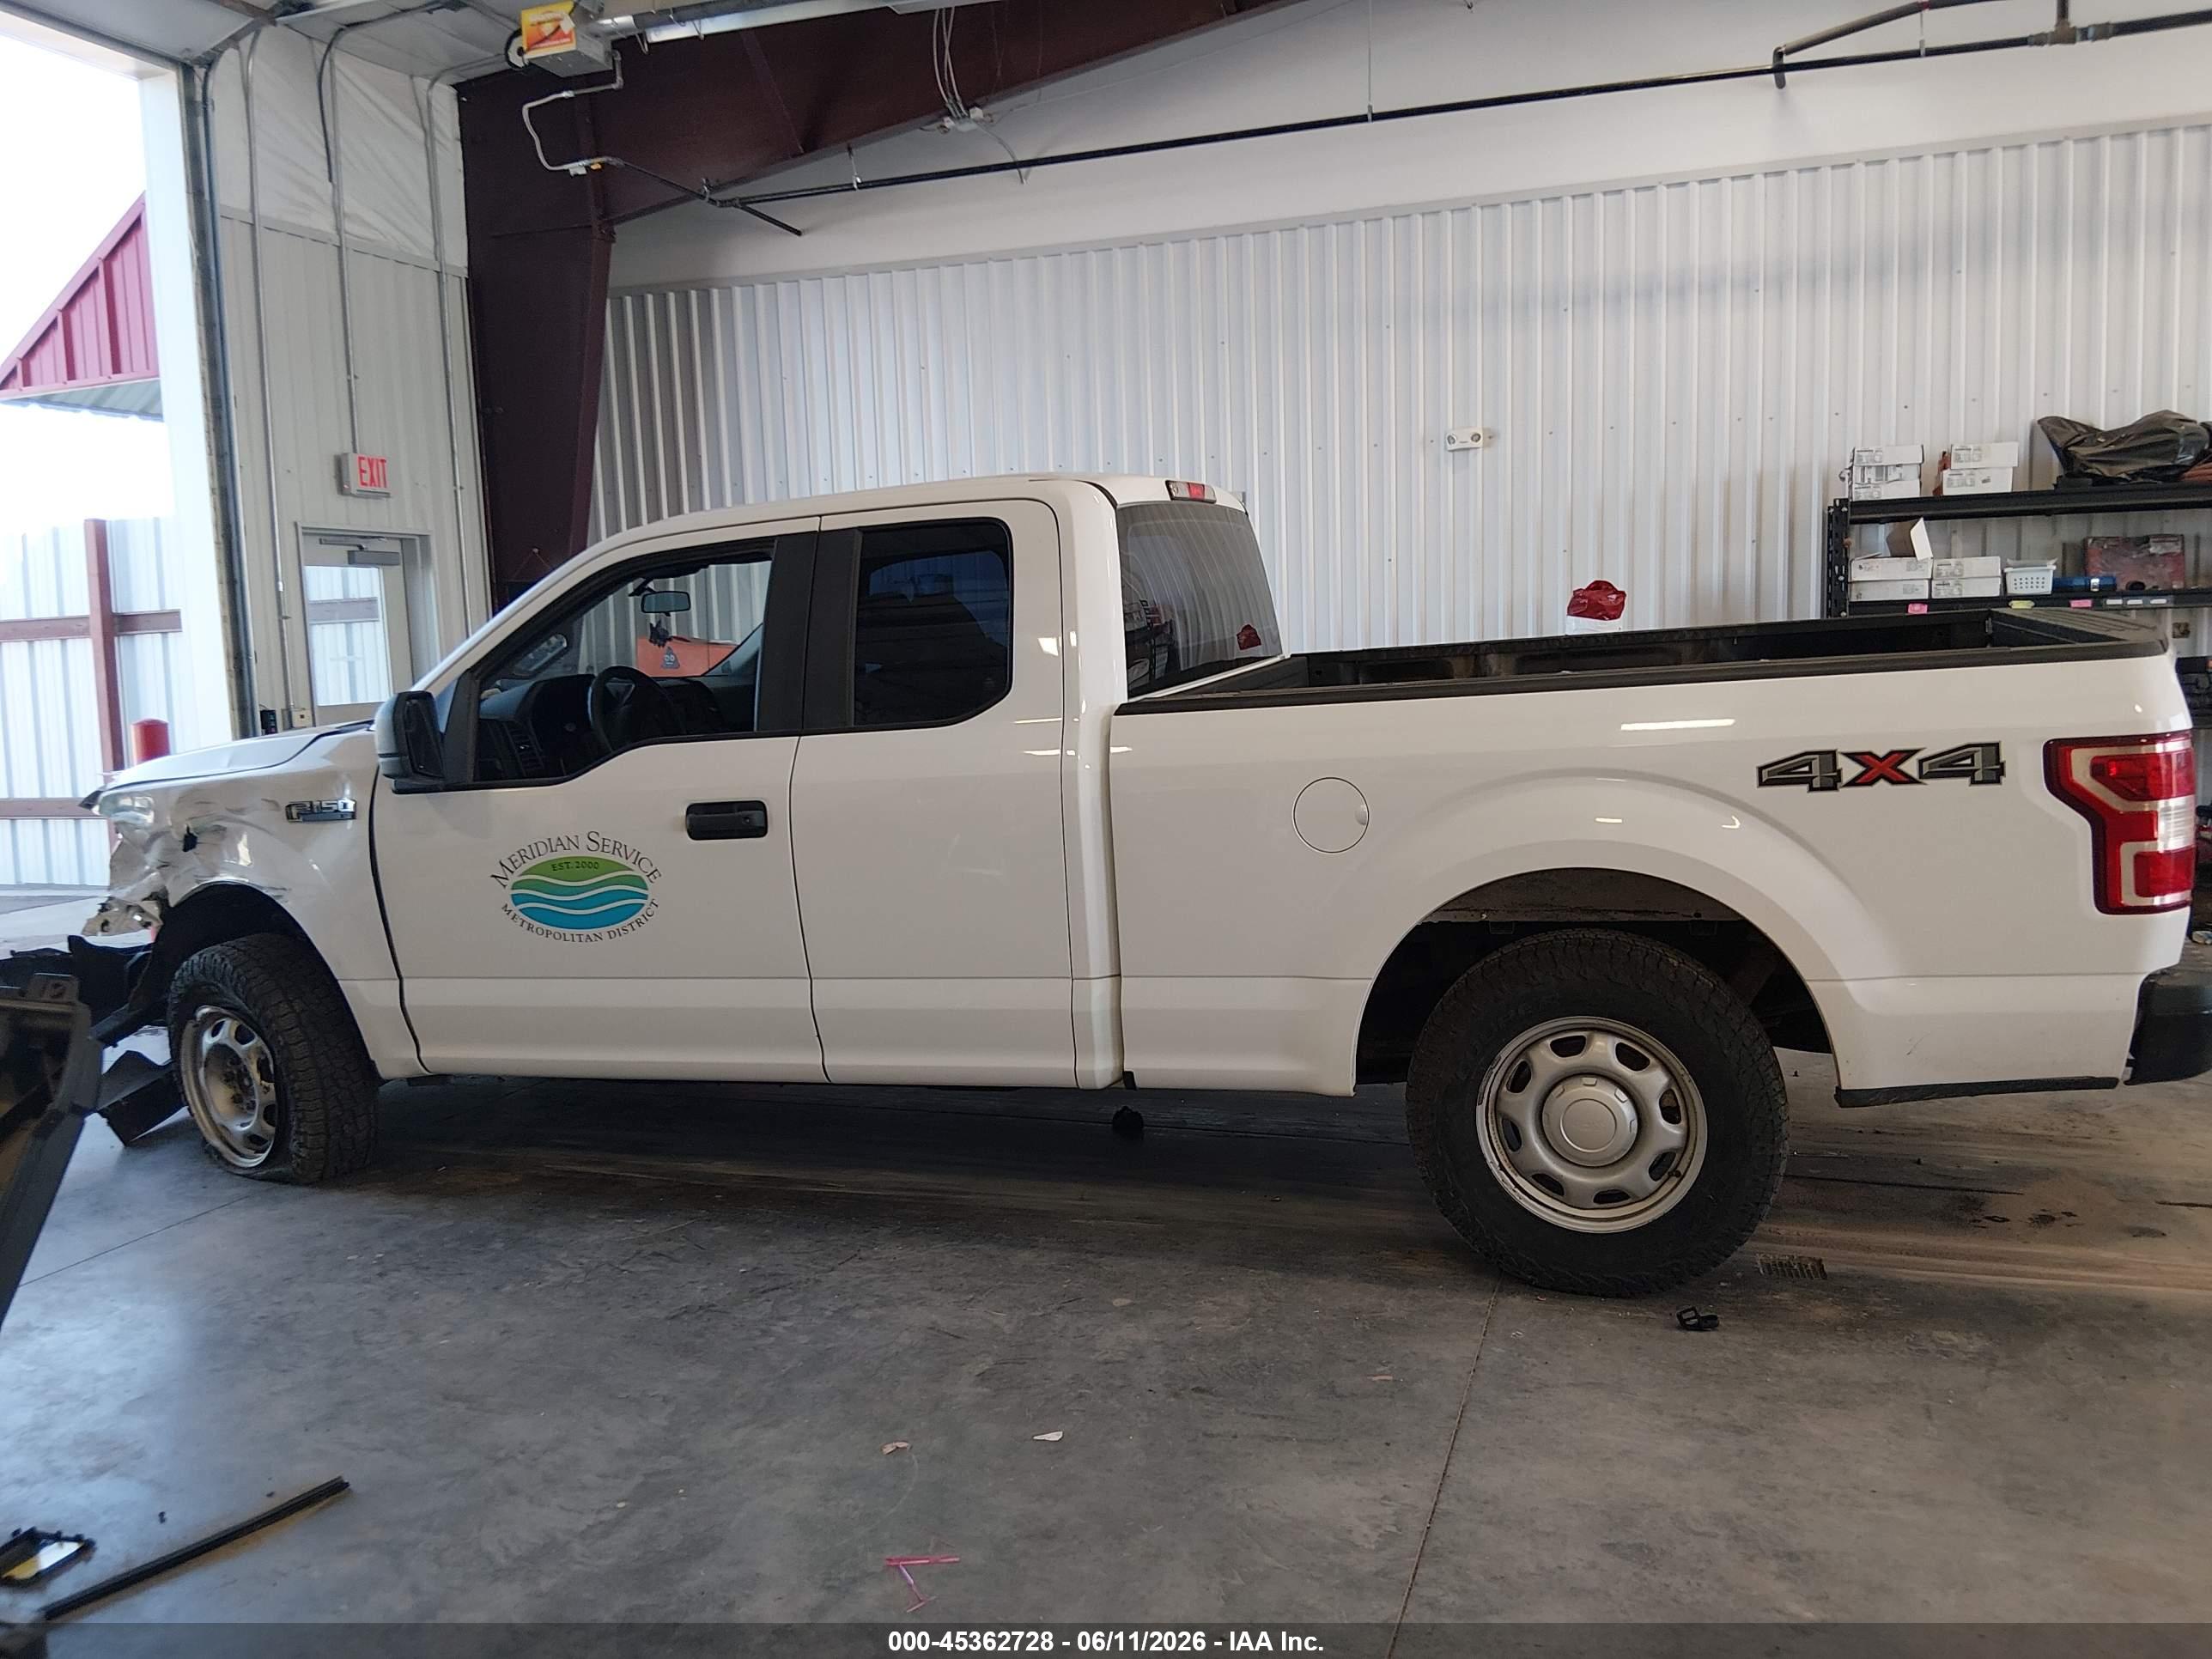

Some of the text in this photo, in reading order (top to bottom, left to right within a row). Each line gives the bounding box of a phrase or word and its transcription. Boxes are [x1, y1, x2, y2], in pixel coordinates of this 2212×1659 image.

[357, 456, 387, 489] EXIT
[490, 830, 661, 889] MERIDIAN SERVICE
[501, 898, 659, 943] METROPOLITAN DISTRICT
